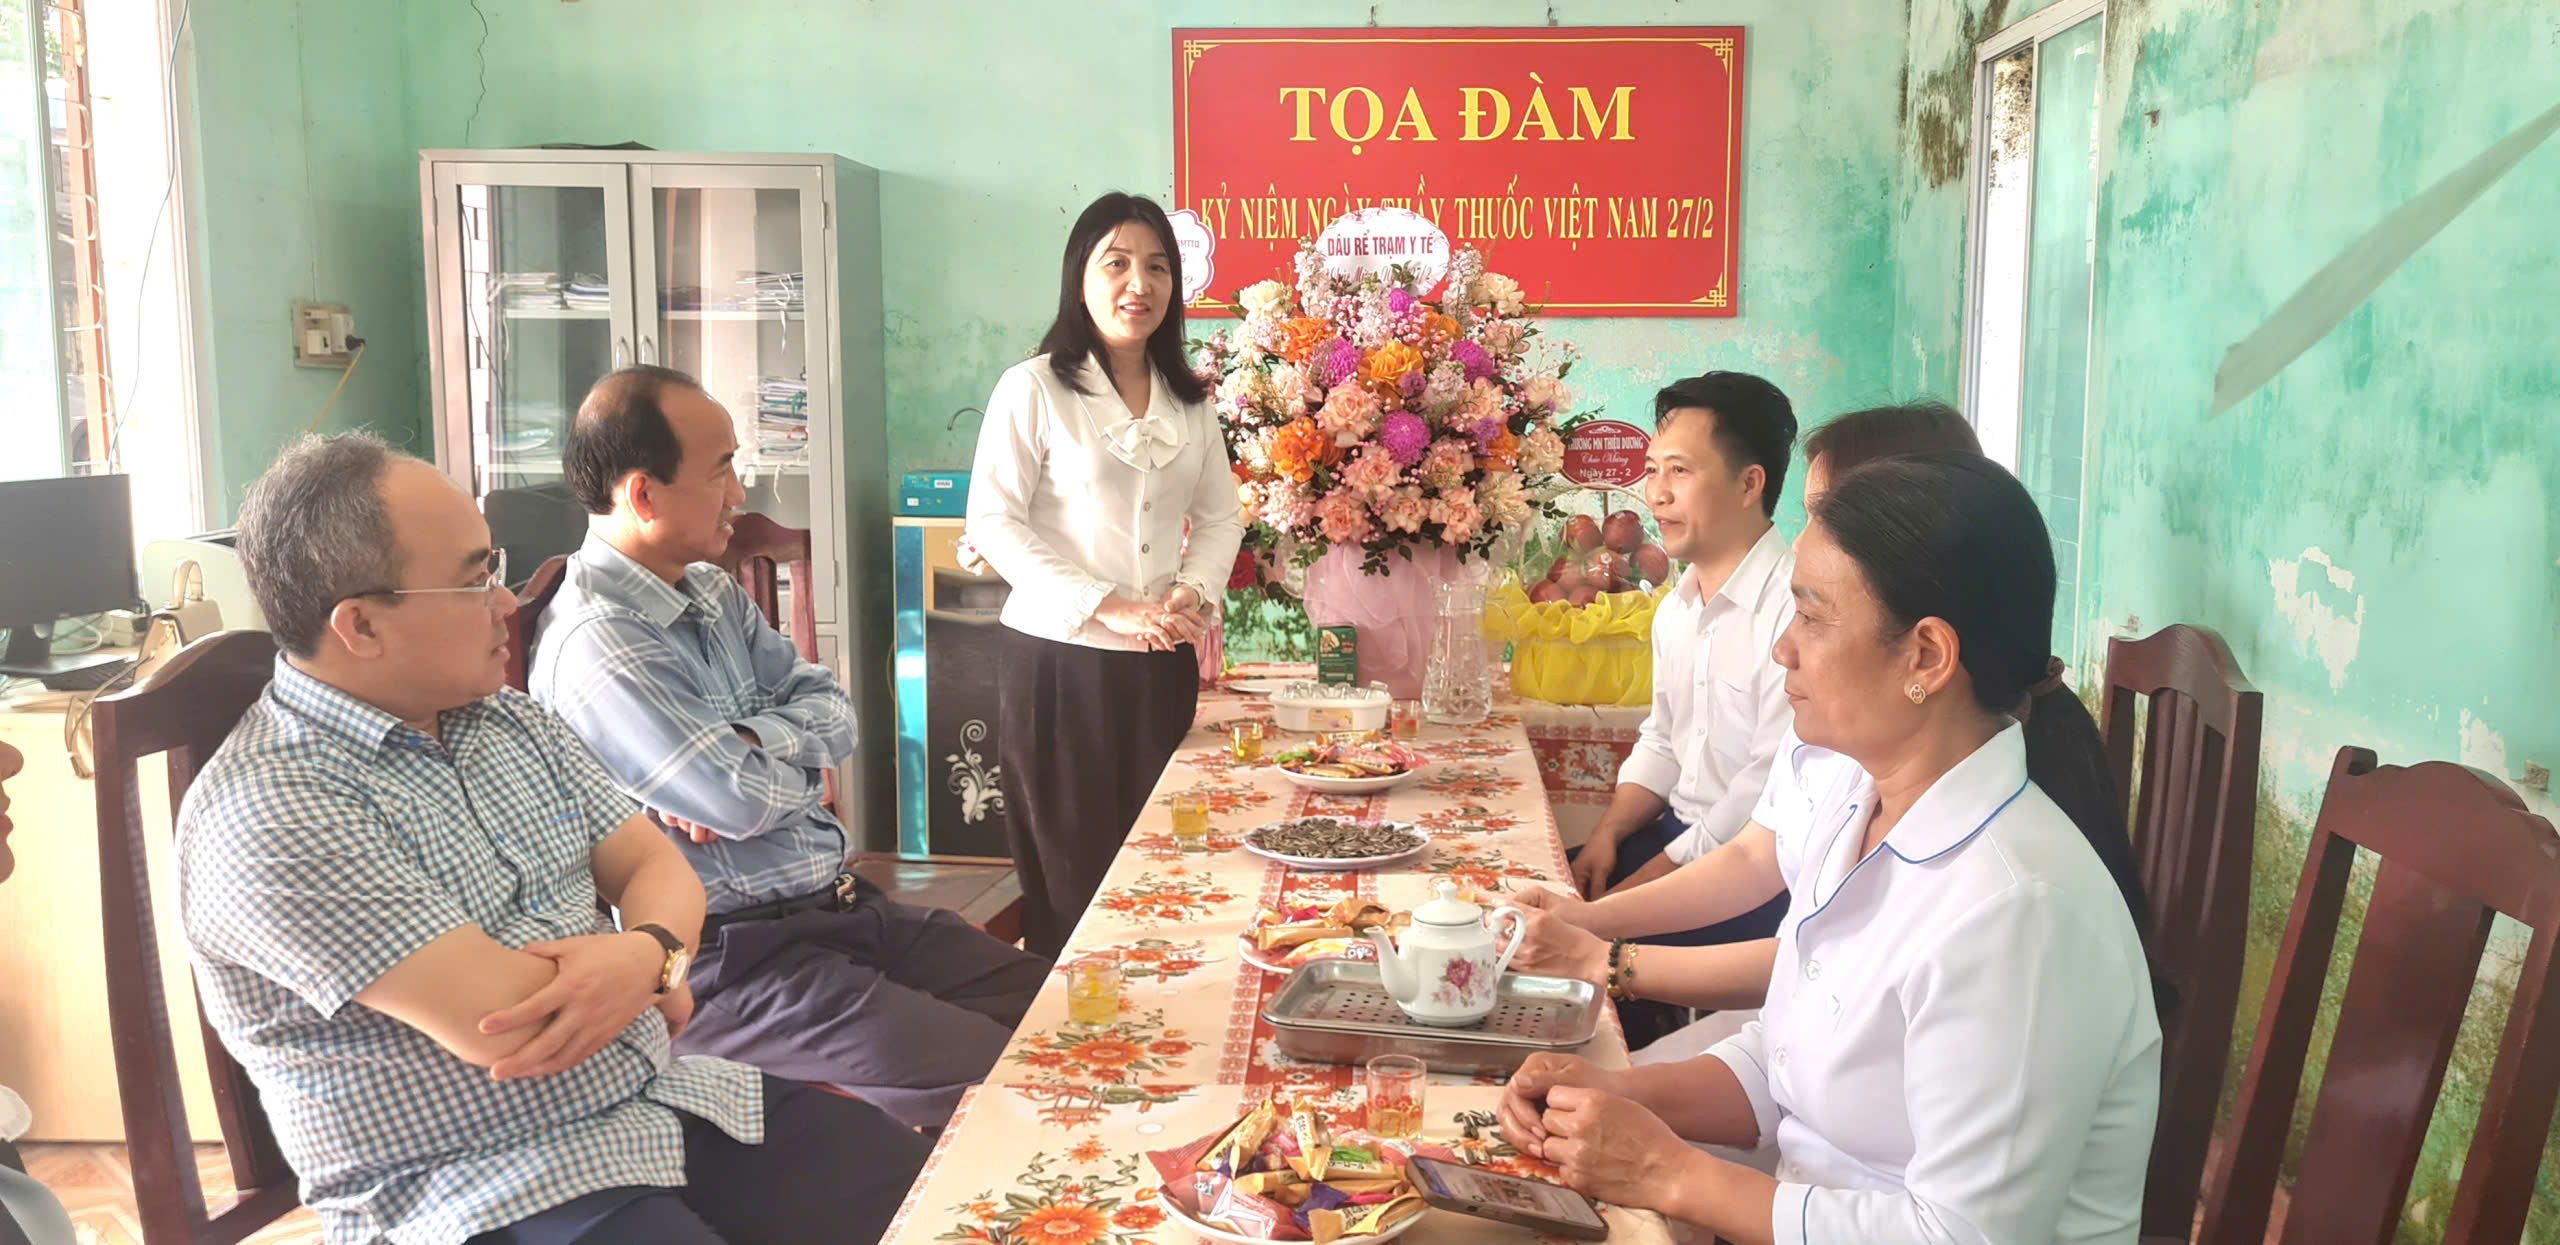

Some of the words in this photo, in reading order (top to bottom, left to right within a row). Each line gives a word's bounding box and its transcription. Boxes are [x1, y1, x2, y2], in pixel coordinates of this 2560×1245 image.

[1280, 86, 1438, 155] TỌA
[1457, 71, 1637, 141] ĐÀM
[1200, 181, 1231, 240] KỶ
[1240, 183, 1298, 251] NIỆM
[1453, 174, 1534, 240] THUỐC
[1543, 182, 1599, 251] VIỆT
[1606, 197, 1658, 239] NAM
[1666, 196, 1714, 240] 27/2
[1372, 235, 1406, 259] TRẠM
[1409, 236, 1417, 255] Y
[1606, 468, 1617, 477] 27
[1625, 468, 1632, 477] 2
